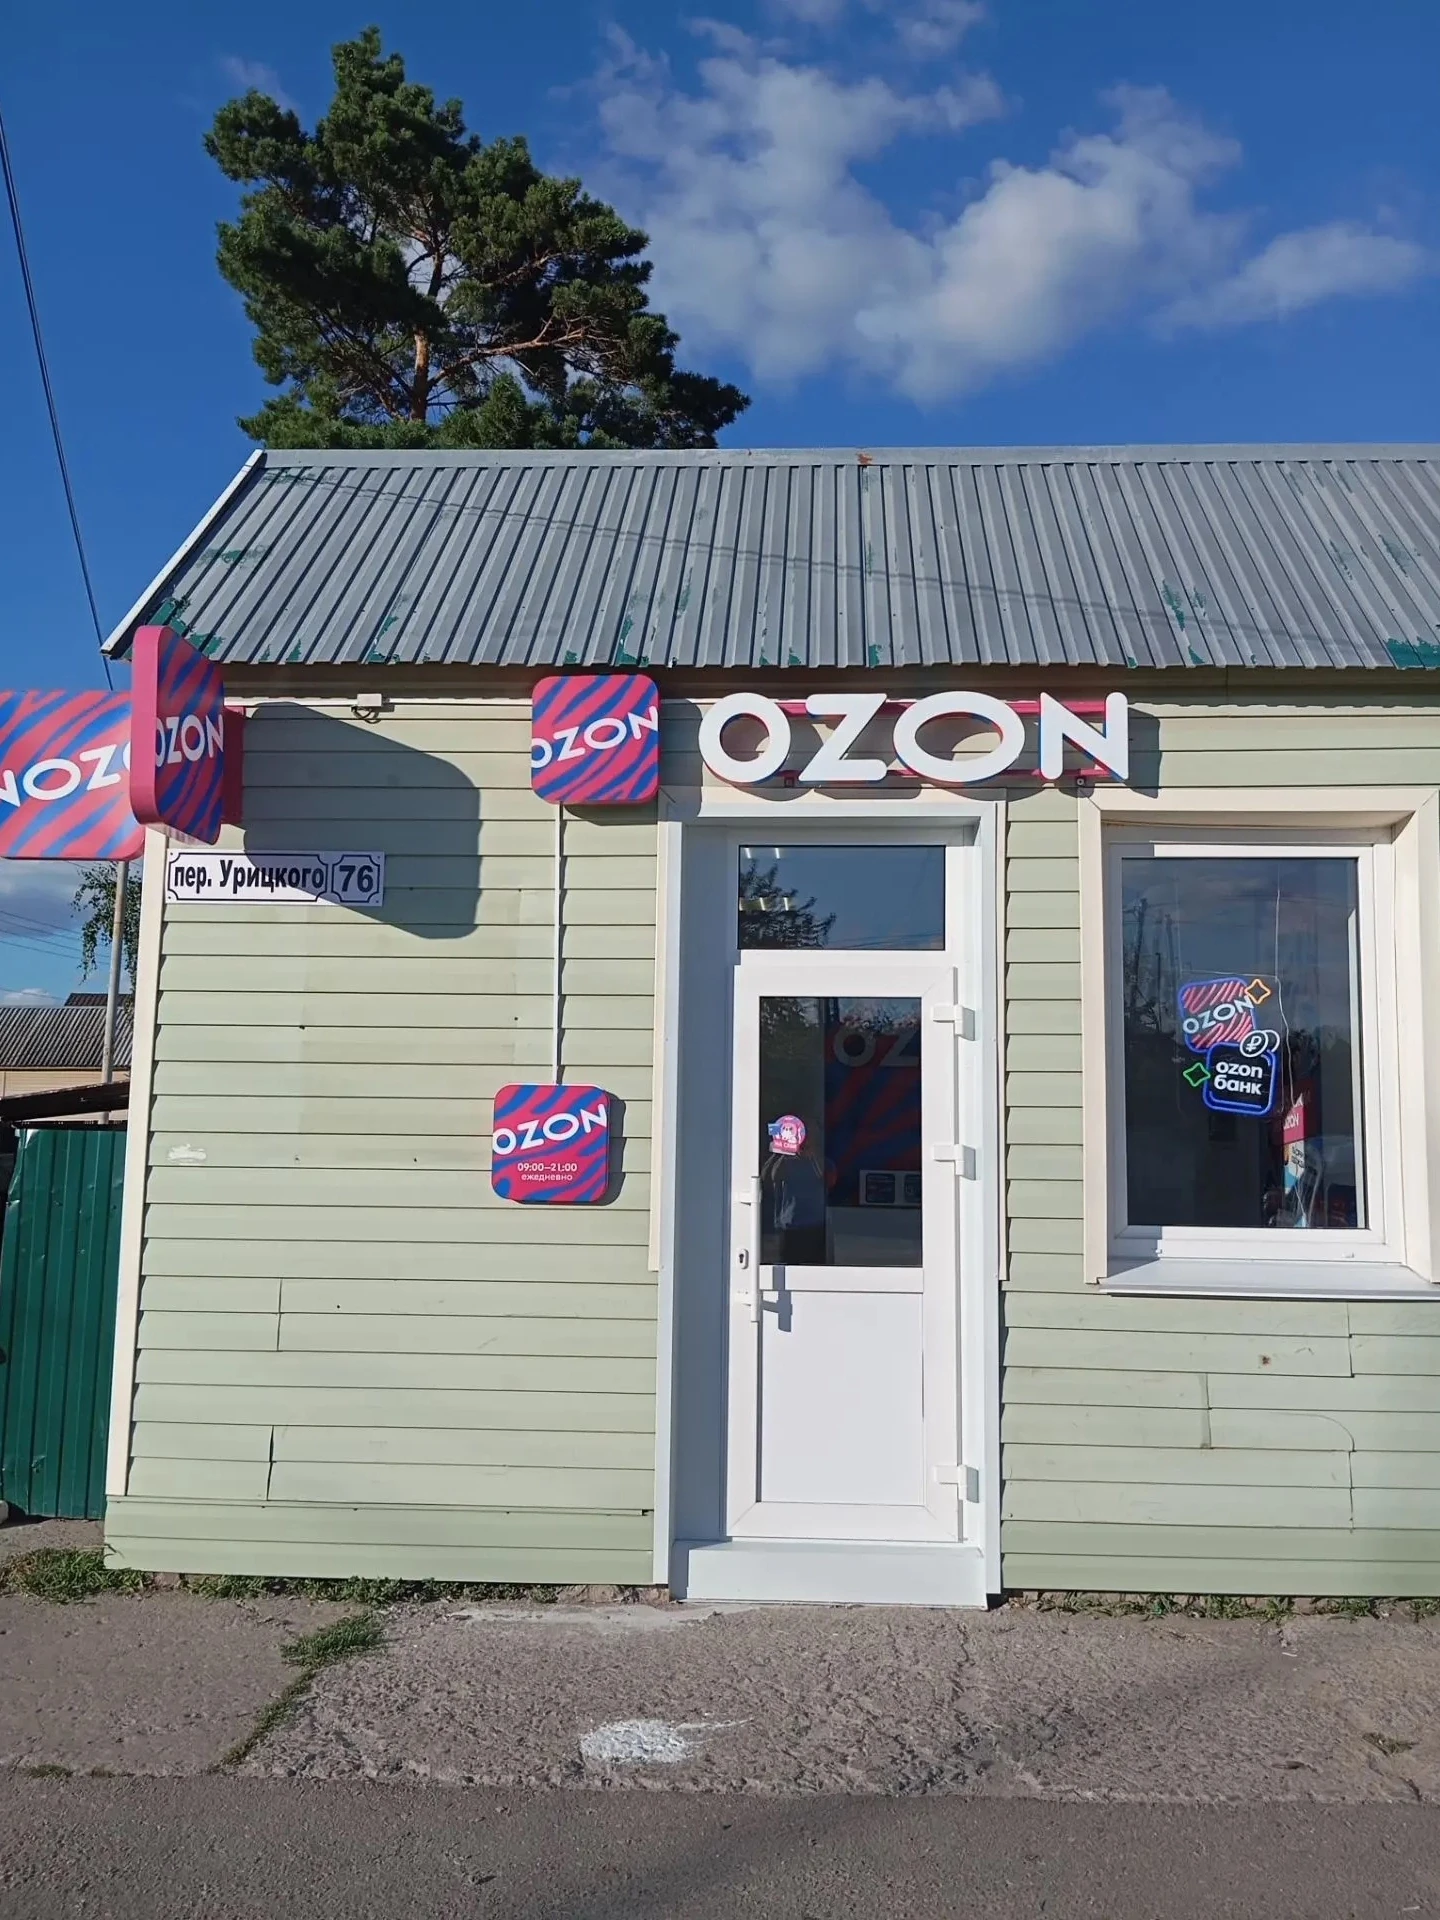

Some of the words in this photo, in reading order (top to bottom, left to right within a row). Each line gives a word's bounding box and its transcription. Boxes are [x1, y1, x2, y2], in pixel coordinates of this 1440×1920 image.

[531, 705, 658, 769] OZON
[698, 690, 1129, 784] OZON
[174, 866, 212, 894] пер.
[220, 859, 325, 895] Урицкого
[339, 865, 374, 893] 76
[1183, 994, 1255, 1034] OZON
[1213, 1074, 1263, 1095] банк
[1215, 1061, 1263, 1079] ozon
[492, 1103, 607, 1155] OZON
